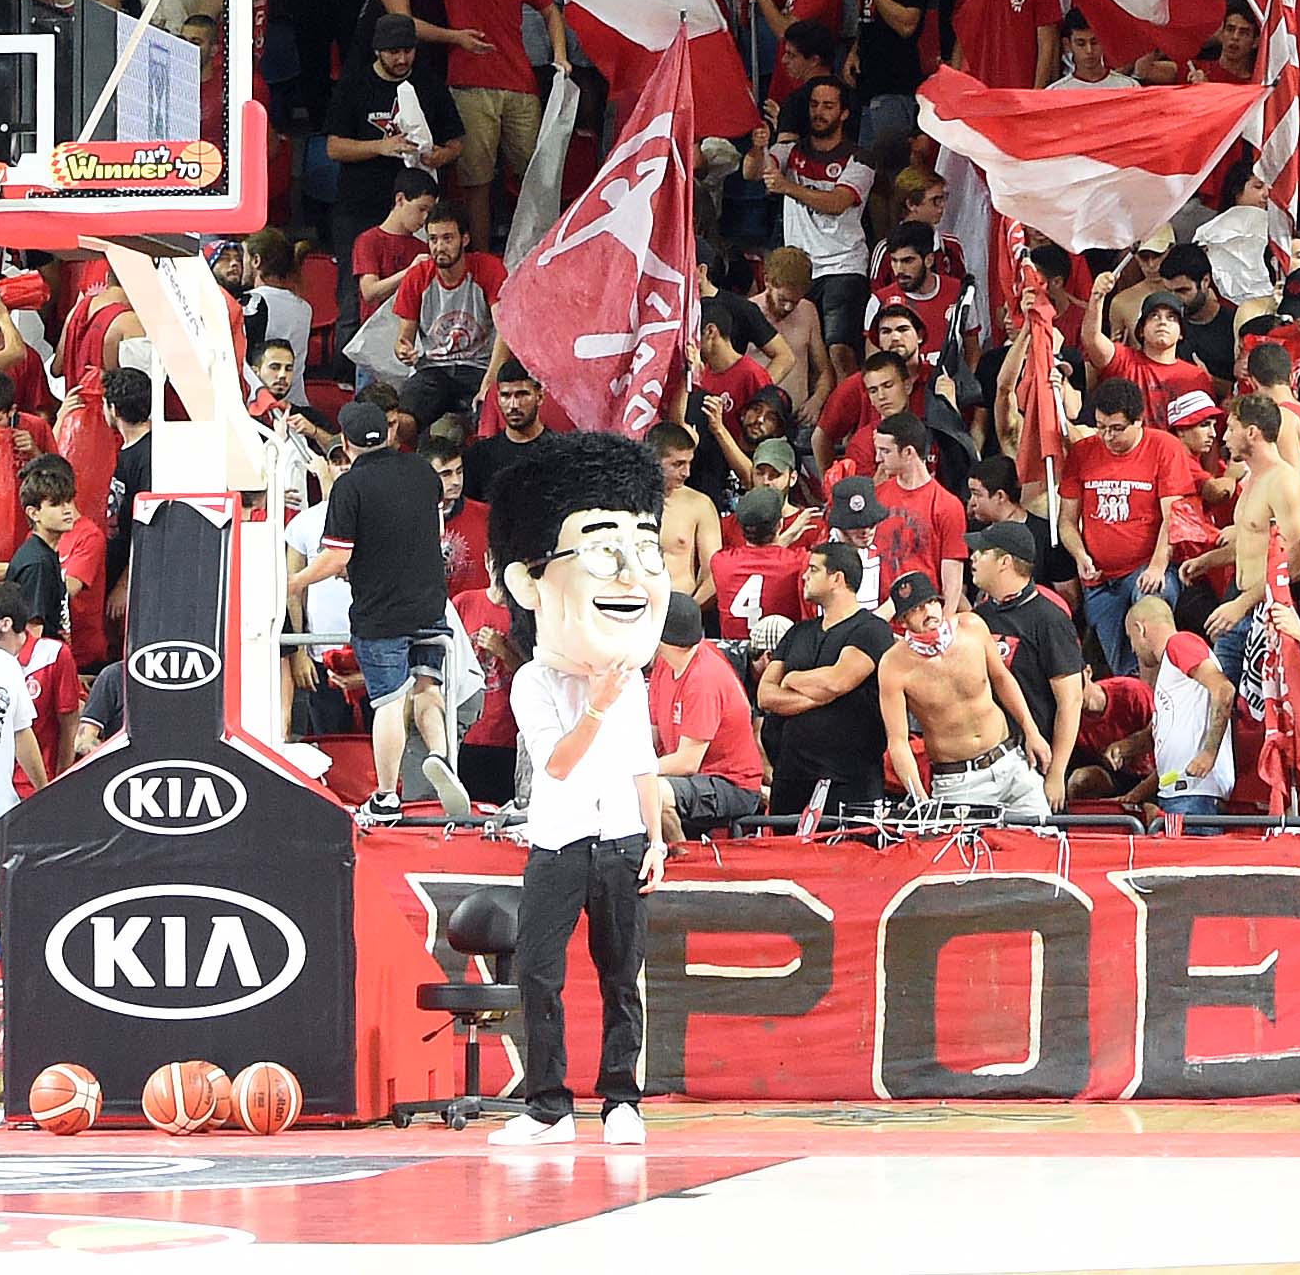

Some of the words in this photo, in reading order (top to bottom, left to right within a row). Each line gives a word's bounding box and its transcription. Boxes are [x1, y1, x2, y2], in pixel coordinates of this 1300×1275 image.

[66, 153, 175, 183] Winner
[729, 574, 764, 628] 4
[144, 646, 203, 680] KIA
[128, 777, 223, 817] KIA
[91, 915, 263, 989] KIA
